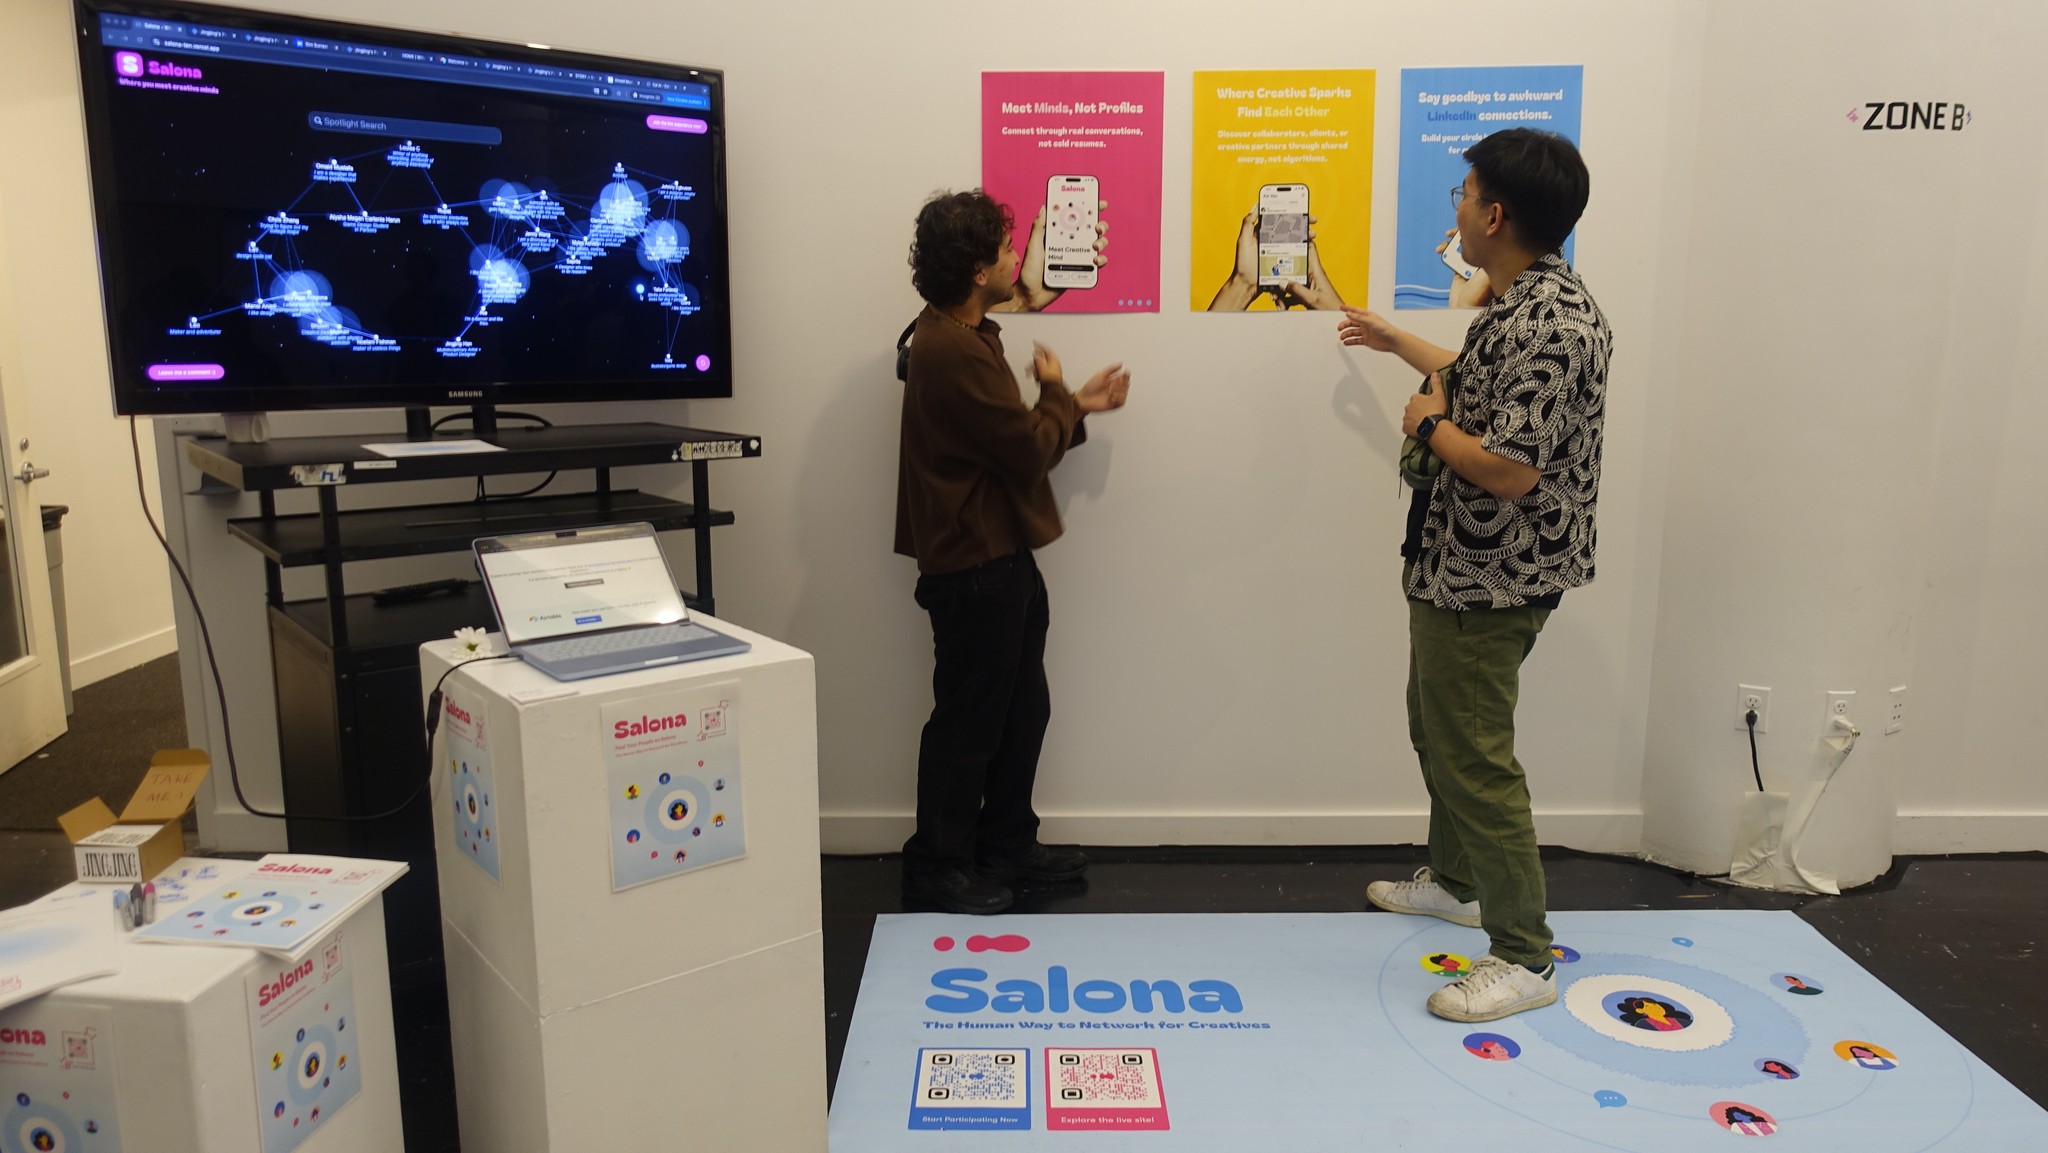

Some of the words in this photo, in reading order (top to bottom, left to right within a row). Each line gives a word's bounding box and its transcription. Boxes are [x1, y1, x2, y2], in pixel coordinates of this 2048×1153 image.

[148, 60, 202, 79] Salona
[119, 77, 142, 87] Where
[142, 80, 154, 89] you
[155, 81, 172, 90] meet
[172, 84, 200, 93] creative
[200, 86, 220, 95] minds
[1217, 87, 1254, 99] Where
[1256, 87, 1307, 98] Creative
[1309, 87, 1352, 100] Sparks
[1418, 92, 1440, 106] Say
[1442, 90, 1491, 105] goodbye
[1493, 91, 1506, 102] to
[1508, 89, 1563, 102] awkward
[1002, 102, 1033, 114] Meet
[1034, 102, 1073, 116] Minds,
[1075, 102, 1097, 114] Not
[1098, 101, 1144, 114] Profiles
[1237, 106, 1262, 118] Find
[1264, 106, 1292, 118] Each
[1295, 106, 1330, 118] Other
[1427, 110, 1476, 122] LinkedIn
[1478, 109, 1552, 121] connections.
[1863, 102, 1948, 130] ZONE
[1951, 103, 1965, 131] B
[324, 116, 359, 129] Spotlight
[360, 120, 387, 131] Search
[1002, 126, 1035, 136] Connect
[1036, 126, 1067, 137] through
[1068, 127, 1084, 135] real
[1085, 127, 1144, 136] conversations,
[1218, 130, 1252, 138] Discover
[1252, 130, 1308, 138] collaborators,
[1309, 129, 1338, 138] clients,
[1038, 139, 1052, 148] not
[1053, 139, 1069, 148] cold
[1070, 140, 1106, 148] resumes.
[1421, 134, 1441, 142] Build
[1442, 135, 1460, 143] your
[1218, 142, 1250, 150] creative
[1251, 142, 1287, 152] partners
[1288, 142, 1320, 152] through
[1321, 142, 1348, 150] shared
[1448, 146, 1460, 155] for
[1237, 156, 1267, 164] energy,
[1268, 155, 1282, 163] not
[1282, 155, 1328, 164] algorithms.
[448, 390, 483, 398] SAMSUNG
[445, 696, 471, 726] Salona
[614, 713, 687, 739] Salona
[638, 739, 654, 747] People
[83, 853, 137, 877] JINGJING
[258, 863, 333, 875] Salona
[259, 959, 314, 1007] Salona
[925, 965, 1243, 1014] Salona
[922, 1020, 953, 1029] The
[957, 1020, 1015, 1029] Human
[1018, 1021, 1053, 1031] Way
[1057, 1021, 1076, 1029] to
[1079, 1020, 1155, 1030] Network
[1158, 1020, 1185, 1029] for
[1187, 1020, 1271, 1030] Creatives
[0, 1028, 46, 1046] ona
[922, 1115, 942, 1123] Start
[944, 1115, 999, 1125] Participating
[1060, 1116, 1096, 1125] Explore
[1098, 1115, 1114, 1123] the
[1116, 1115, 1133, 1123] live
[1134, 1115, 1155, 1123] site!
